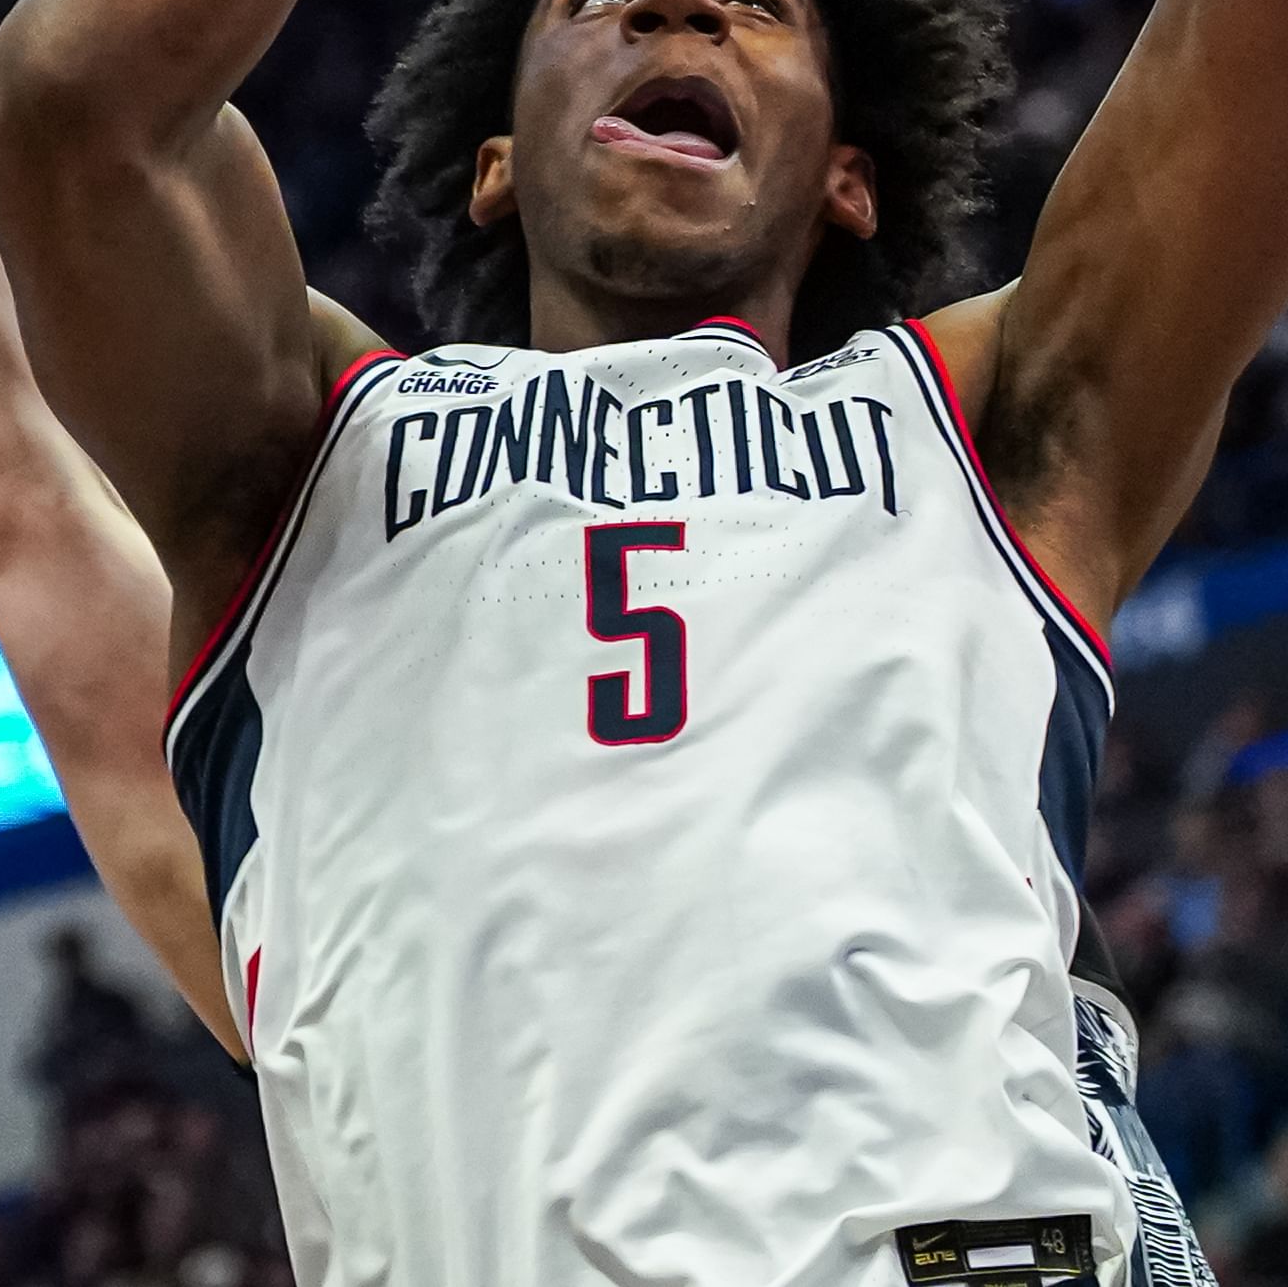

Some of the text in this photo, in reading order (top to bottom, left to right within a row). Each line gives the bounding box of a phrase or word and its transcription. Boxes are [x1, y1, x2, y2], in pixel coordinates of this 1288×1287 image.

[397, 377, 500, 395] CHANGE
[385, 369, 898, 544] CONNECTICUT
[584, 522, 687, 745] 5
[1039, 1228, 1066, 1255] 48
